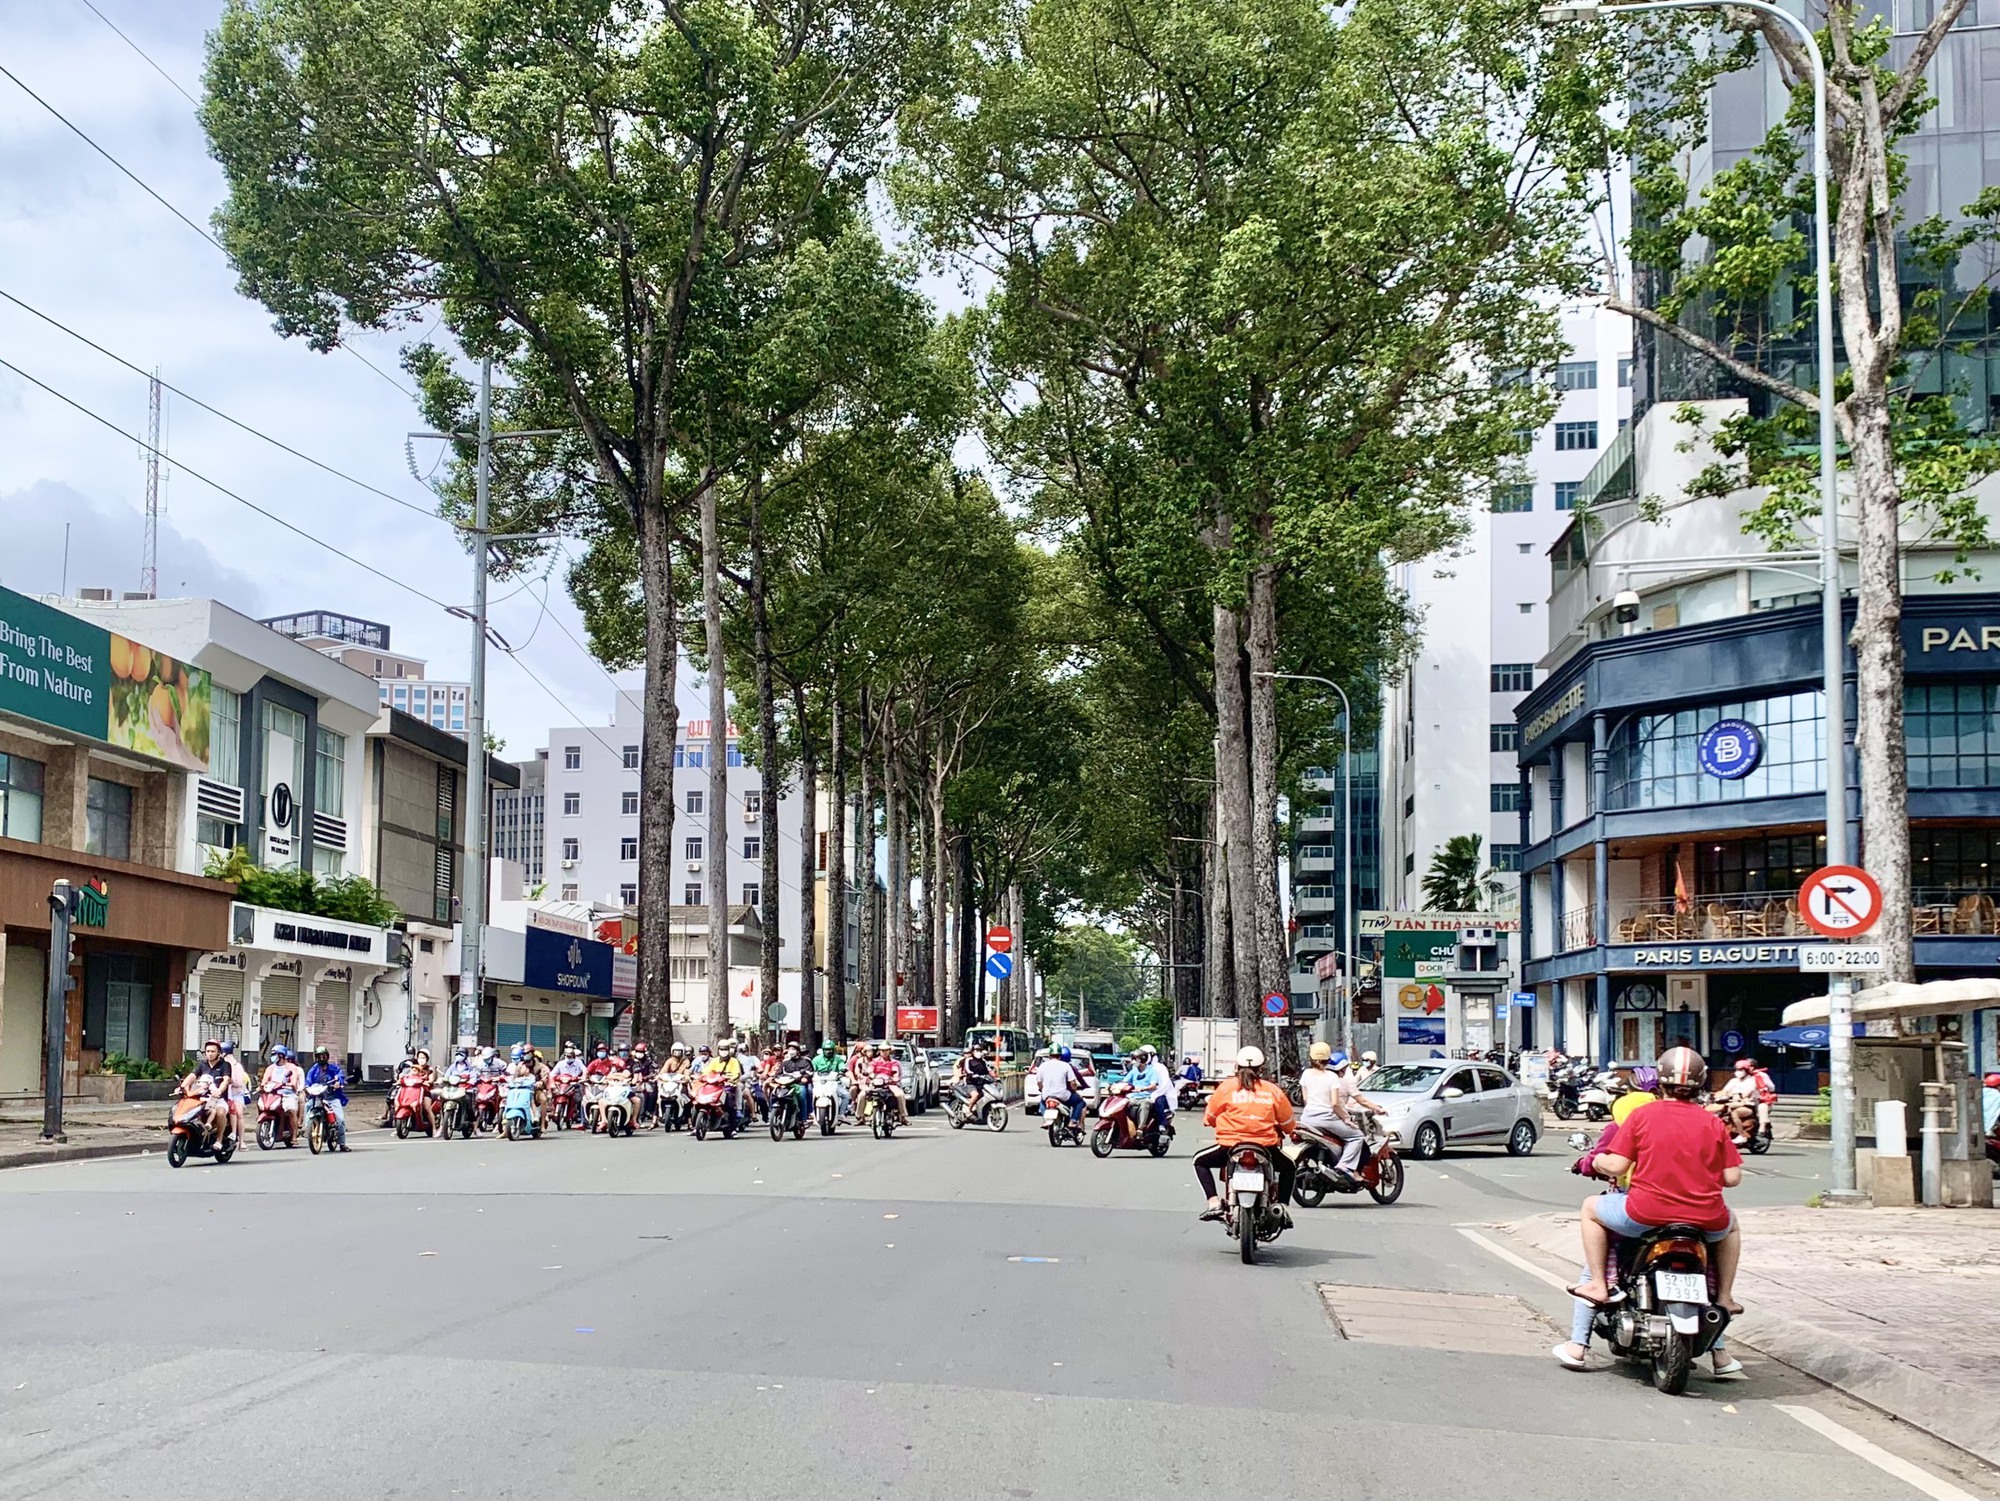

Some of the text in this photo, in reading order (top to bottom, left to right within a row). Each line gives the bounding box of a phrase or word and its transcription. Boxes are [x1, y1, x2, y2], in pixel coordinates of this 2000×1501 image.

[0, 620, 93, 674] Bring The Best
[0, 651, 92, 705] From Nature
[1361, 919, 1386, 928] TTM
[1394, 917, 1426, 930] TÂN
[1634, 945, 1800, 965] PARIS BAGUETT
[1807, 952, 1836, 965] 6:00
[1845, 952, 1880, 965] 22:00
[1665, 1286, 1700, 1301] 7393
